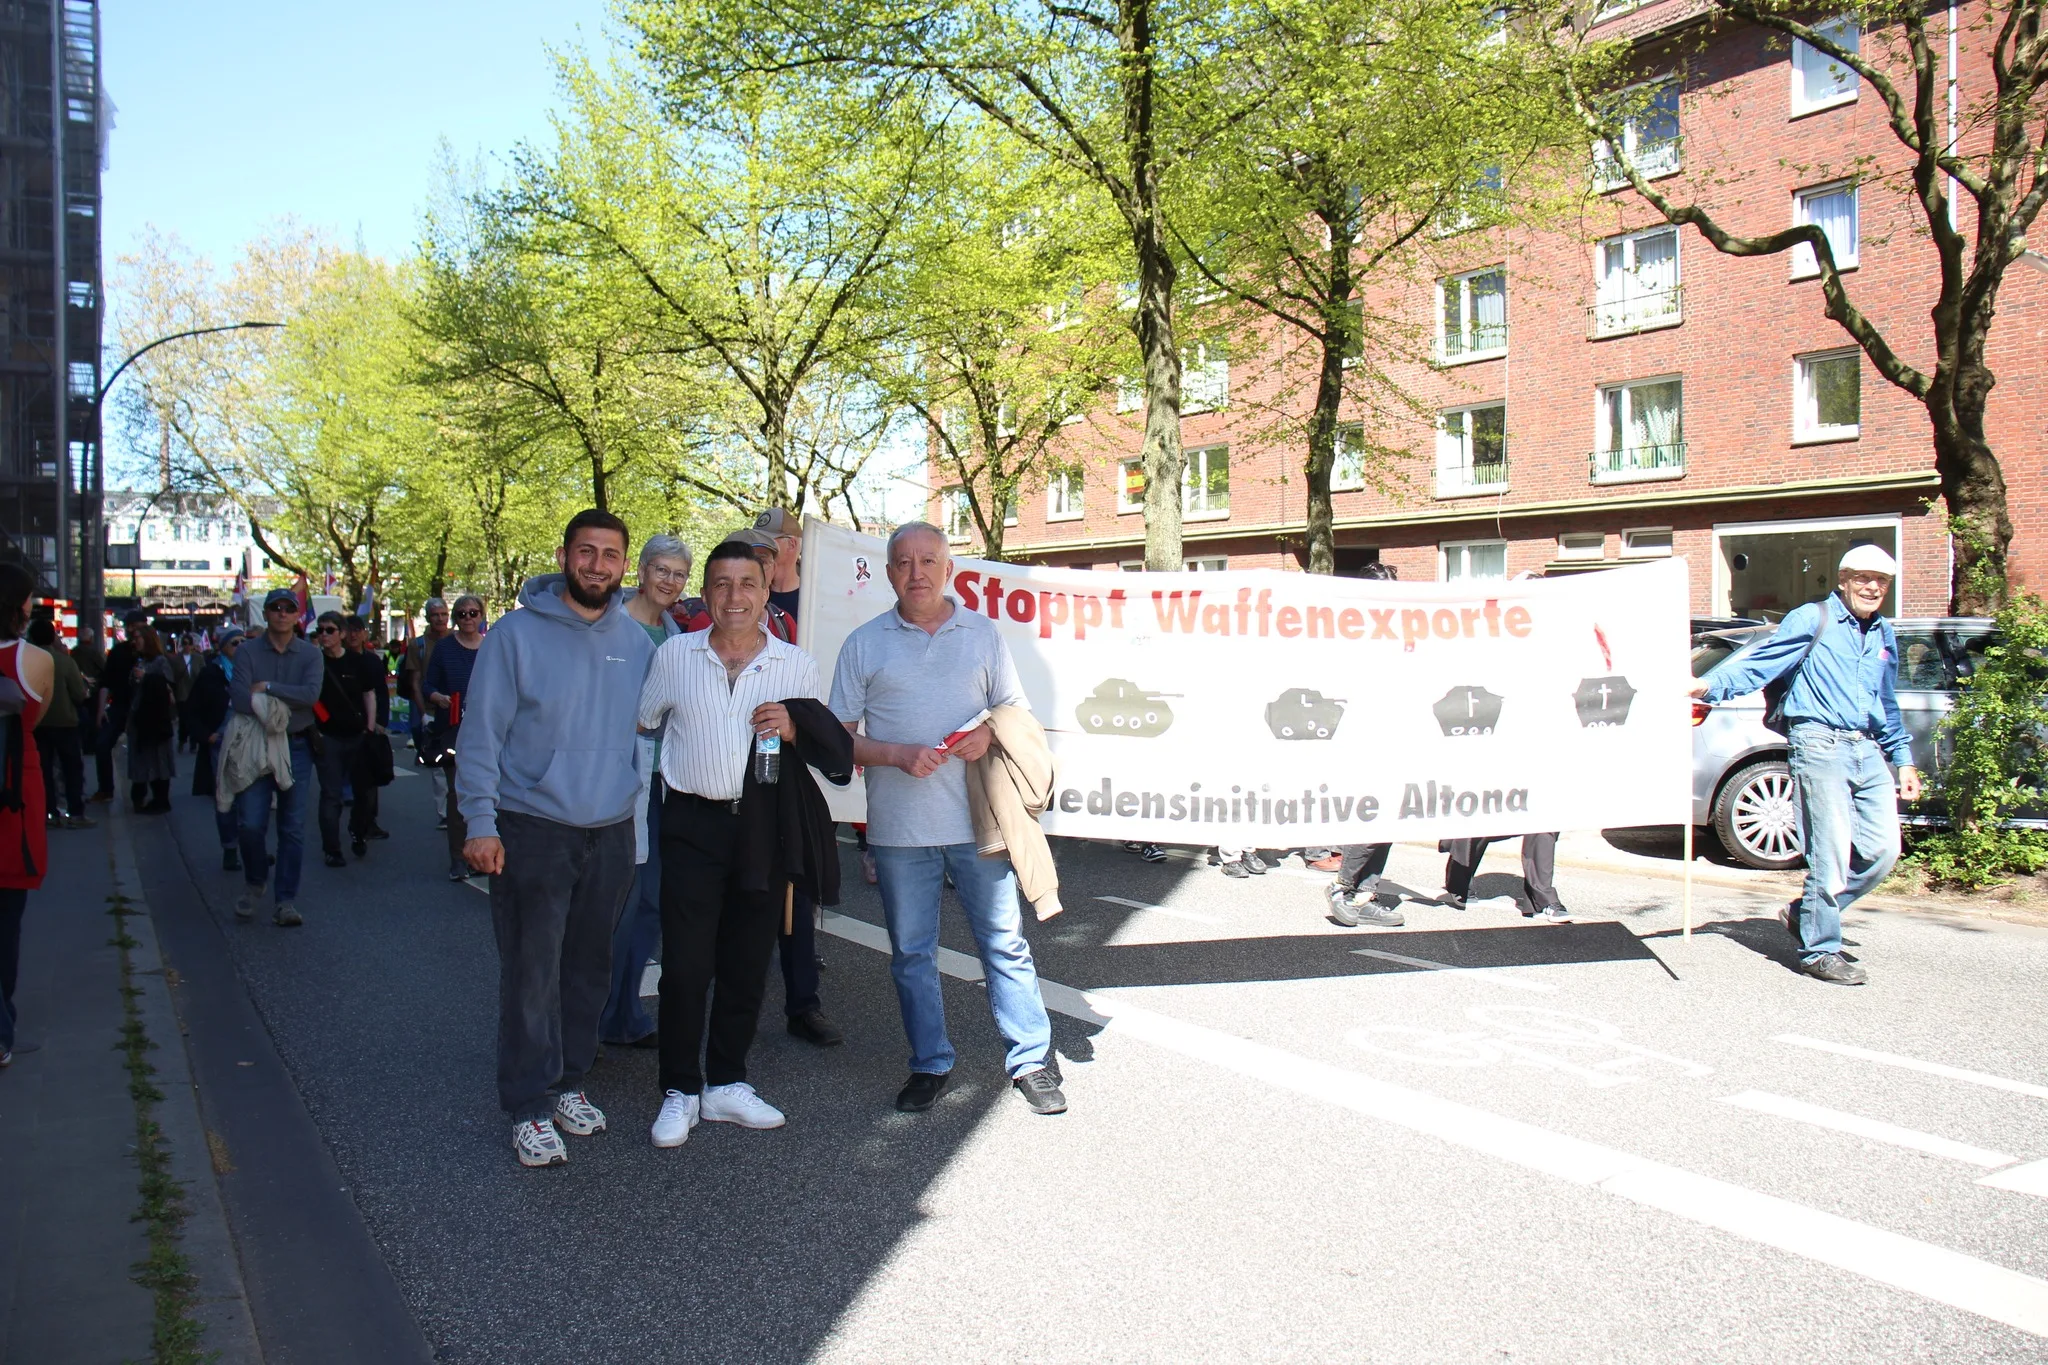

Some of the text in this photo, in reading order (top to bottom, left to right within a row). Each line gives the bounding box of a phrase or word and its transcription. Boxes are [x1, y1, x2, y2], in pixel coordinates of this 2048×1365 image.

[954, 571, 1533, 652] Stoppt Waffenexporte
[1397, 780, 1528, 820] Altona
